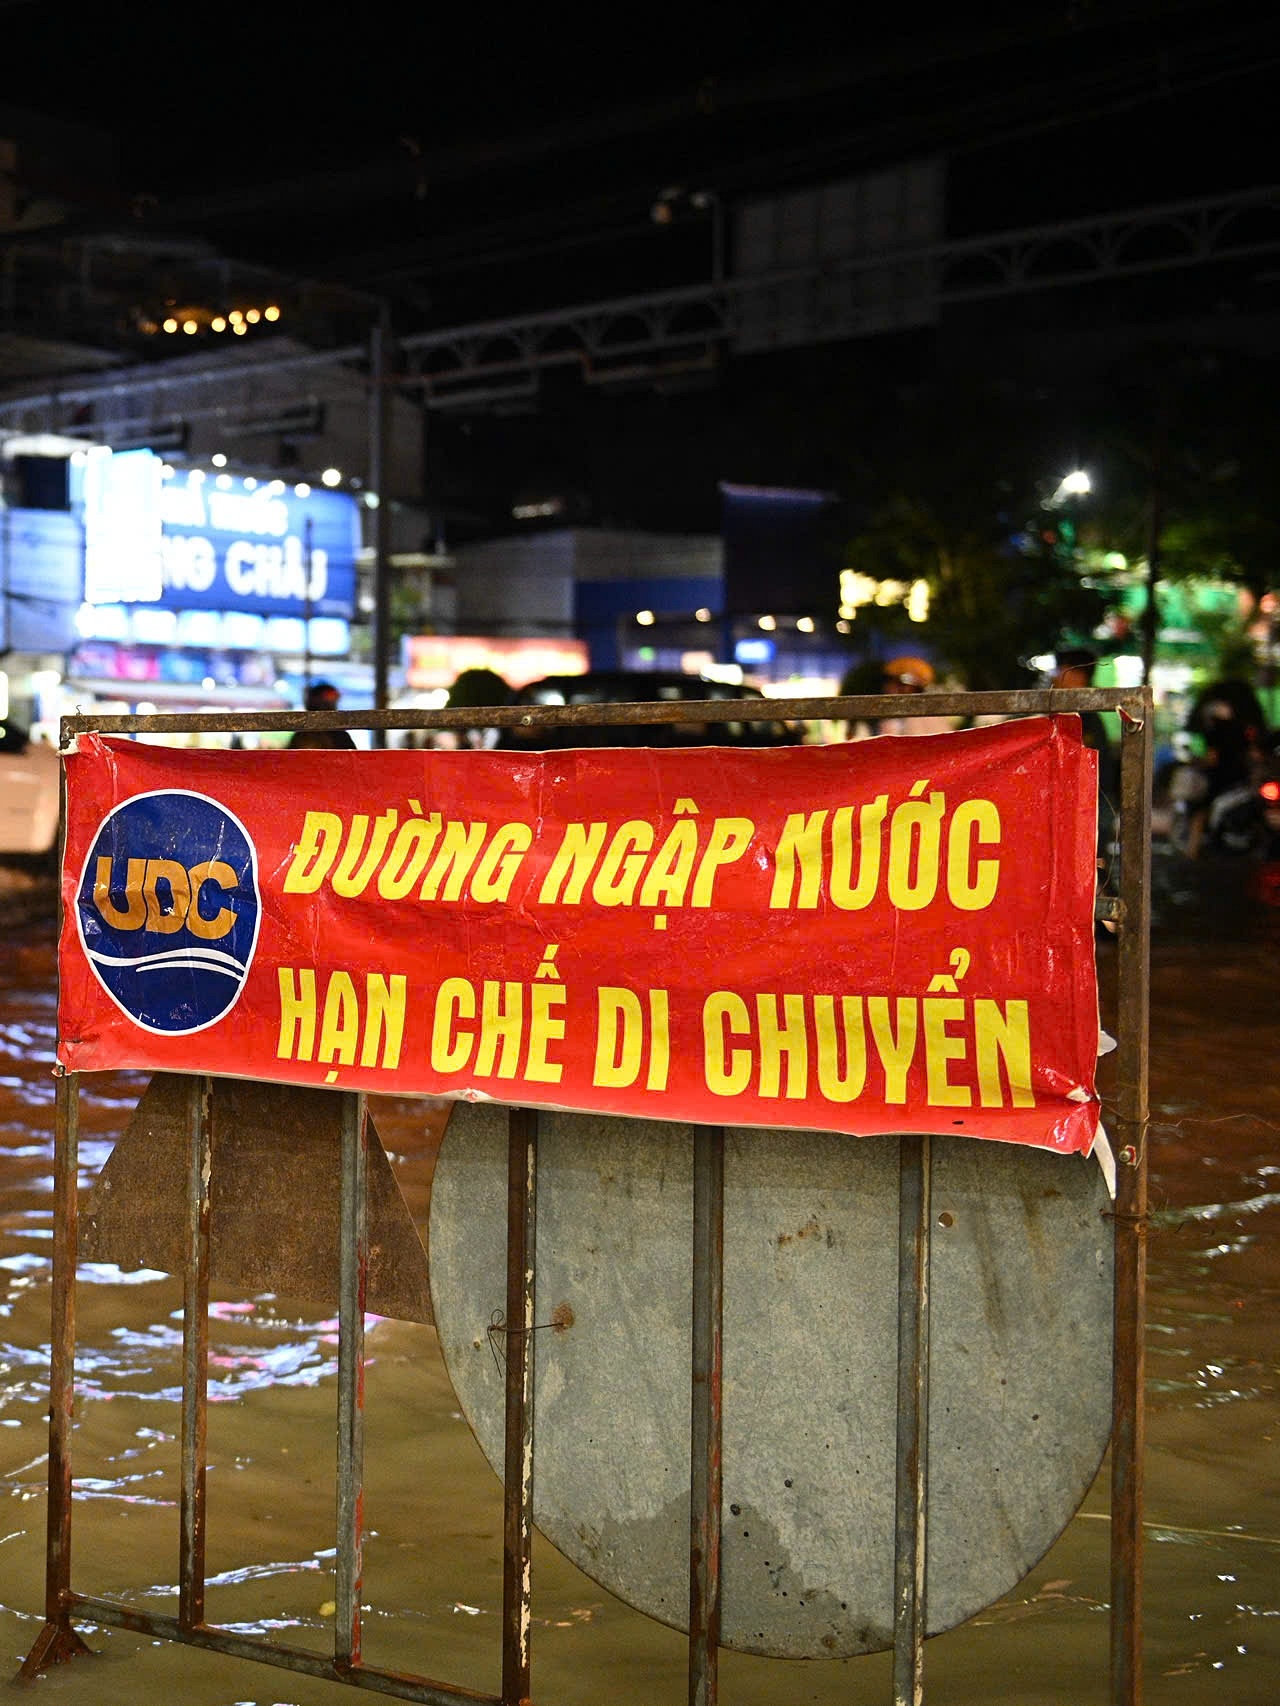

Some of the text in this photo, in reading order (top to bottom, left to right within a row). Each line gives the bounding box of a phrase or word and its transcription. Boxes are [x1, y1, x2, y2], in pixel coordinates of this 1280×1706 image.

[93, 855, 240, 940] UDC
[283, 779, 1001, 931] ĐƯỜNG NGẬP NƯỚC
[276, 943, 1036, 1108] HẠN CHẾ DI CHUYỂN
